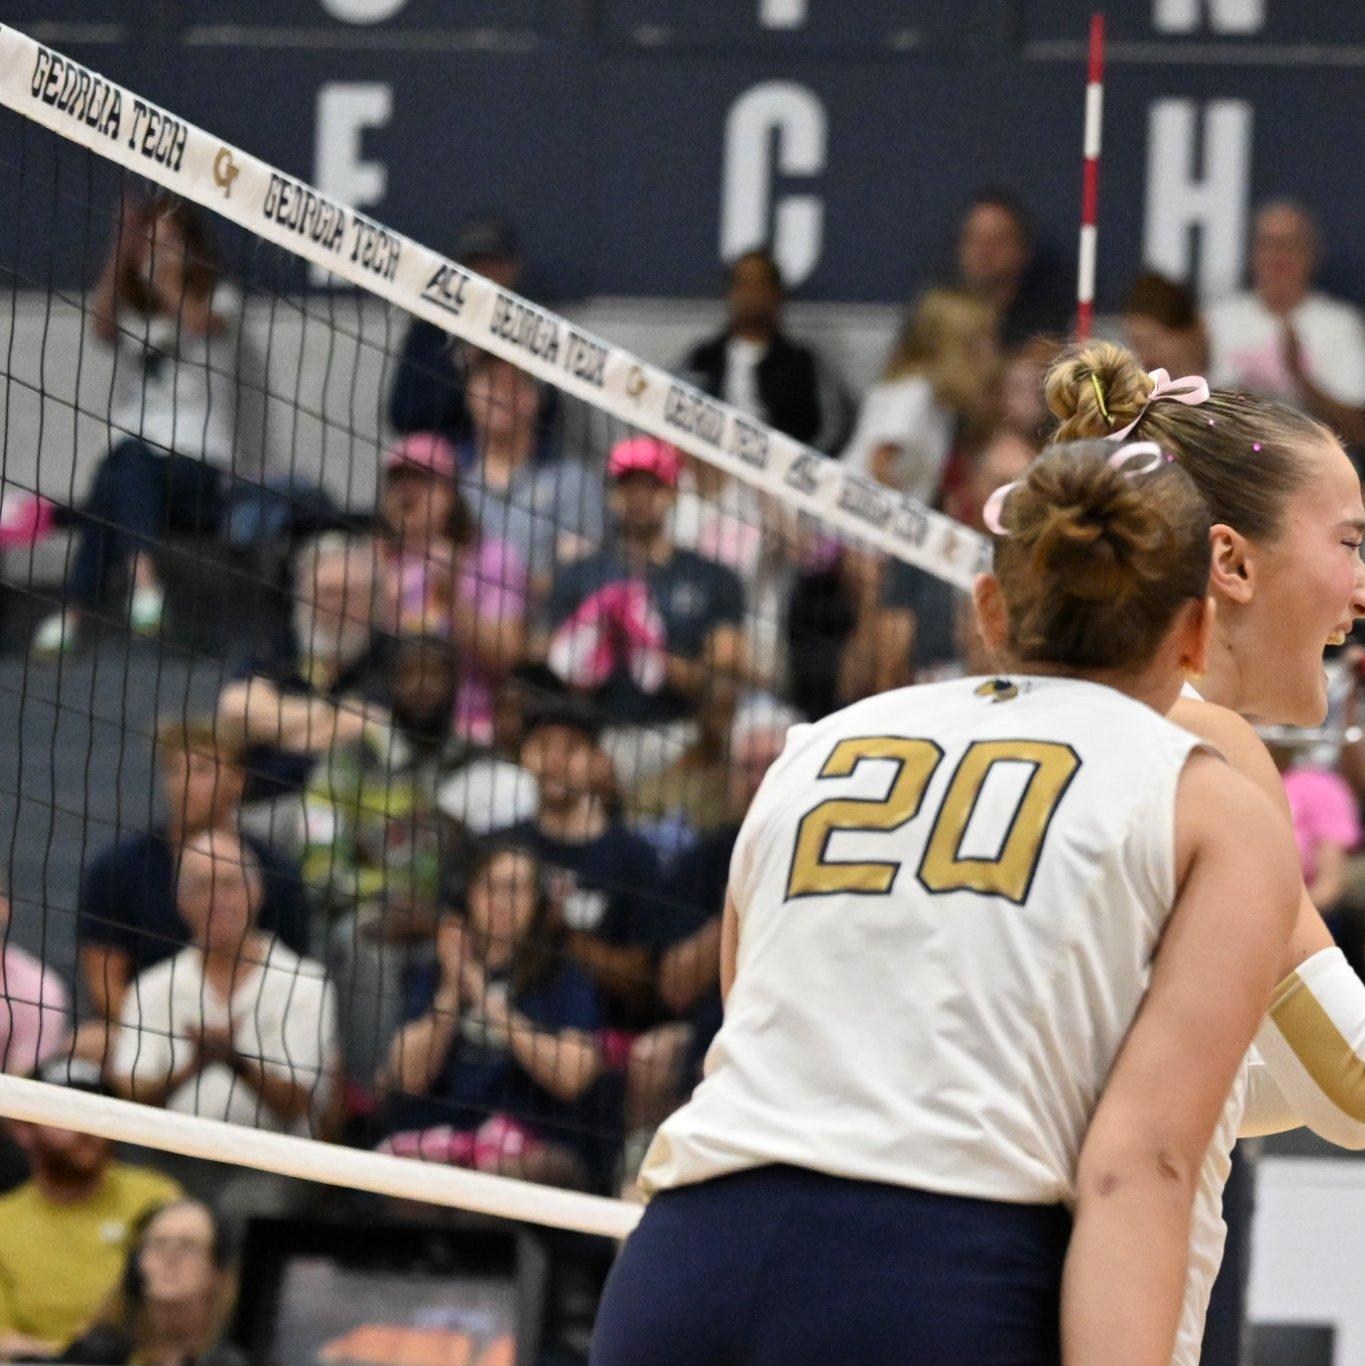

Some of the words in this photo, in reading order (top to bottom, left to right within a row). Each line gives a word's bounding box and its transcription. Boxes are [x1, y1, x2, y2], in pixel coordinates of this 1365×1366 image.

[30, 47, 122, 140] GEORGIA
[128, 100, 189, 172] TECH
[262, 173, 344, 253] GEORGIA
[350, 215, 402, 283] TECH
[783, 735, 1084, 907] 20
